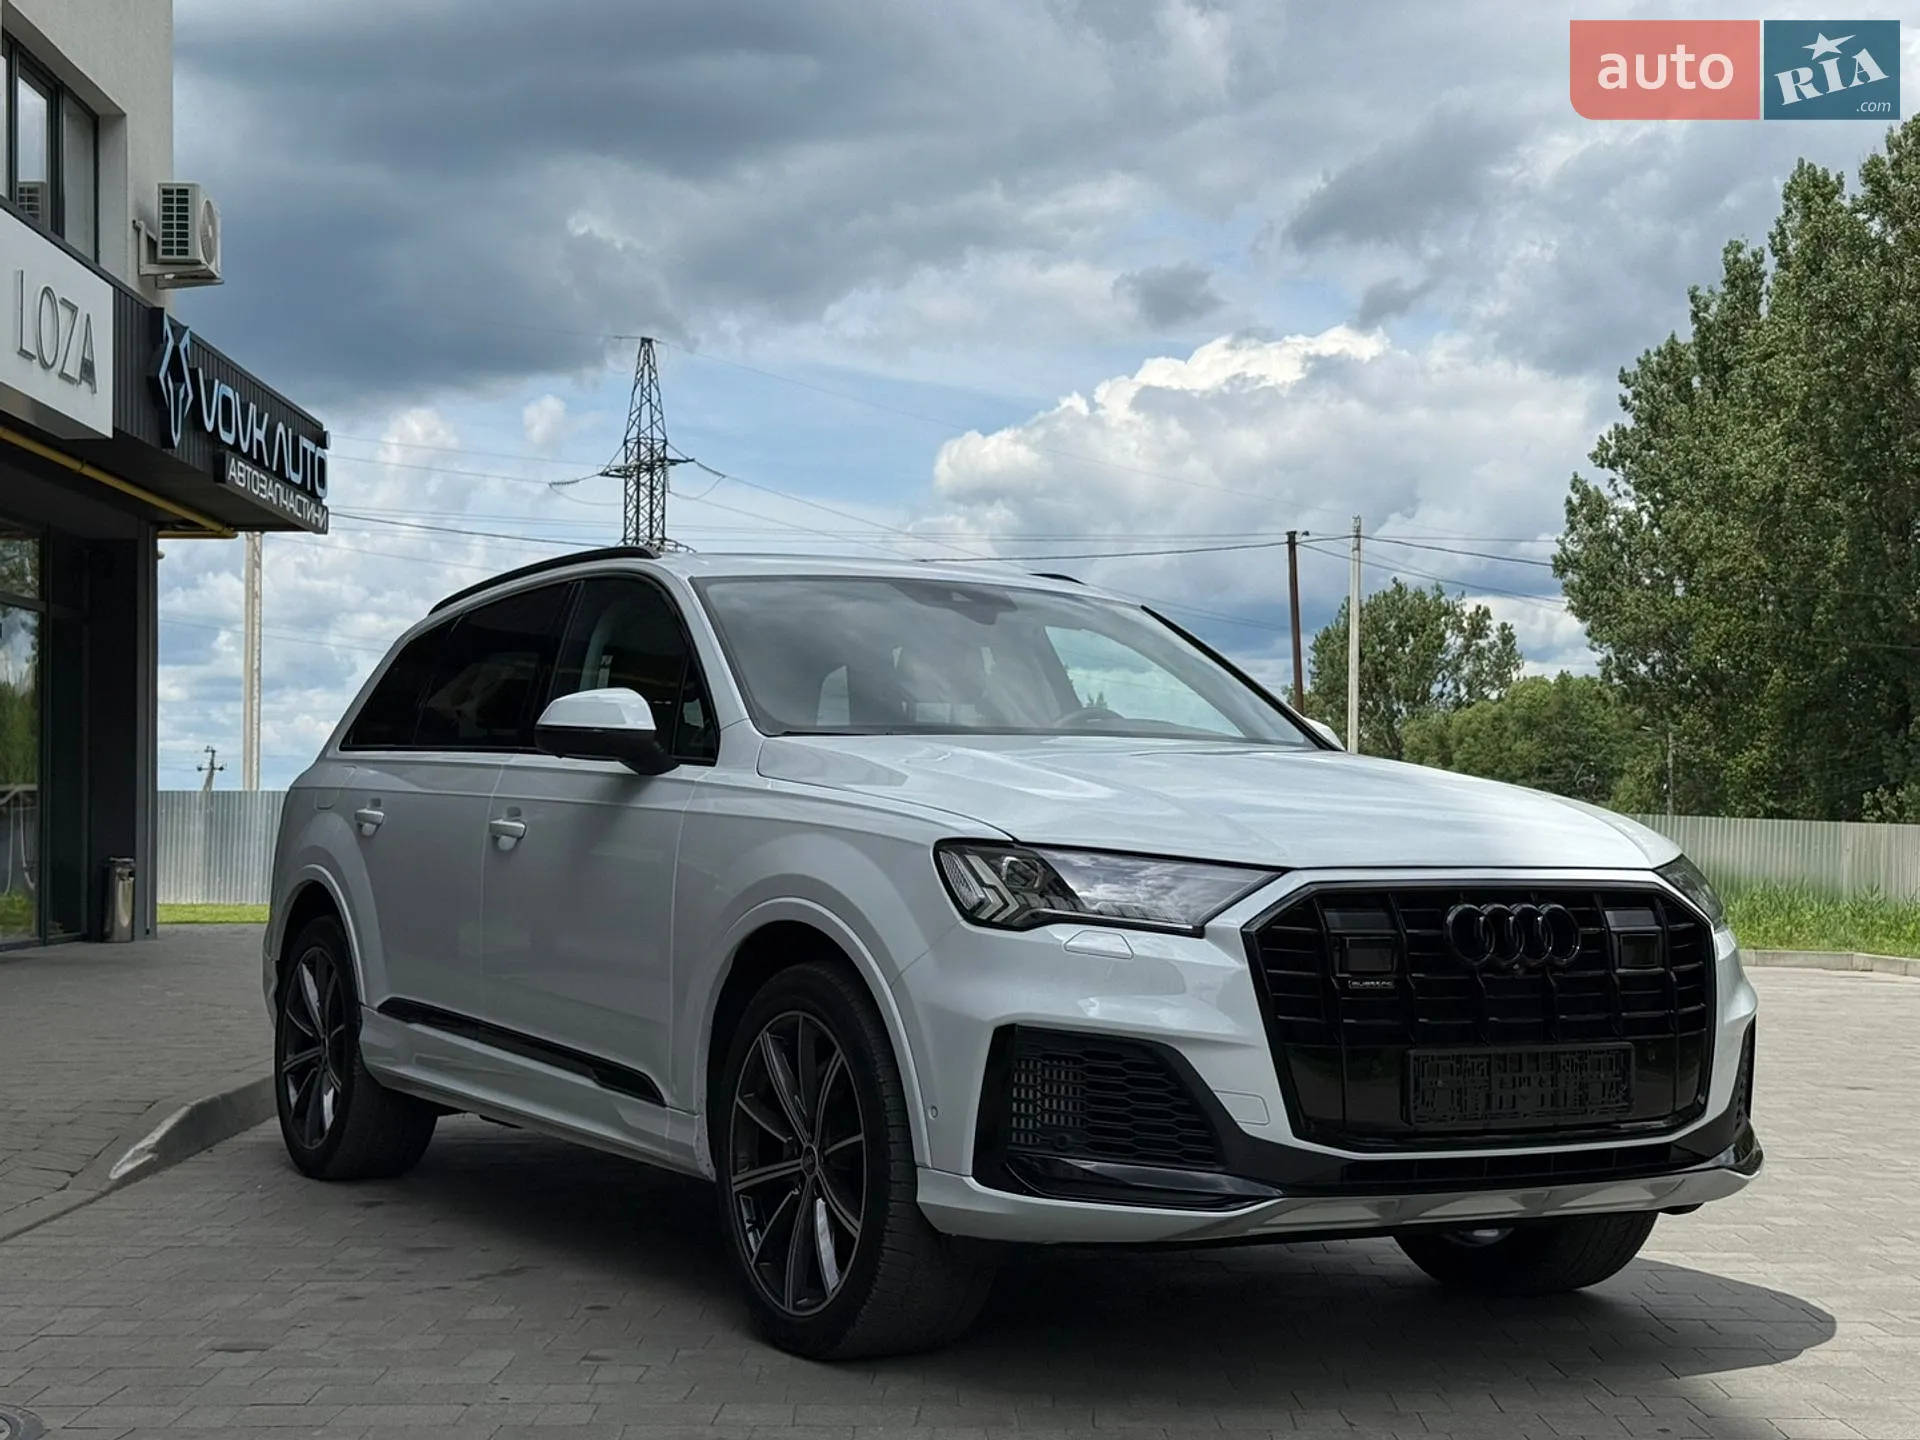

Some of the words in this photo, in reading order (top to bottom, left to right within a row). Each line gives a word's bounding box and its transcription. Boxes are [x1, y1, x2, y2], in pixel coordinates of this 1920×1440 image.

[16, 268, 97, 395] LOZA
[198, 367, 270, 468] VOVK
[272, 421, 328, 499] AUTO
[228, 457, 328, 531] АВТОЗАПЧАСТИНИ
